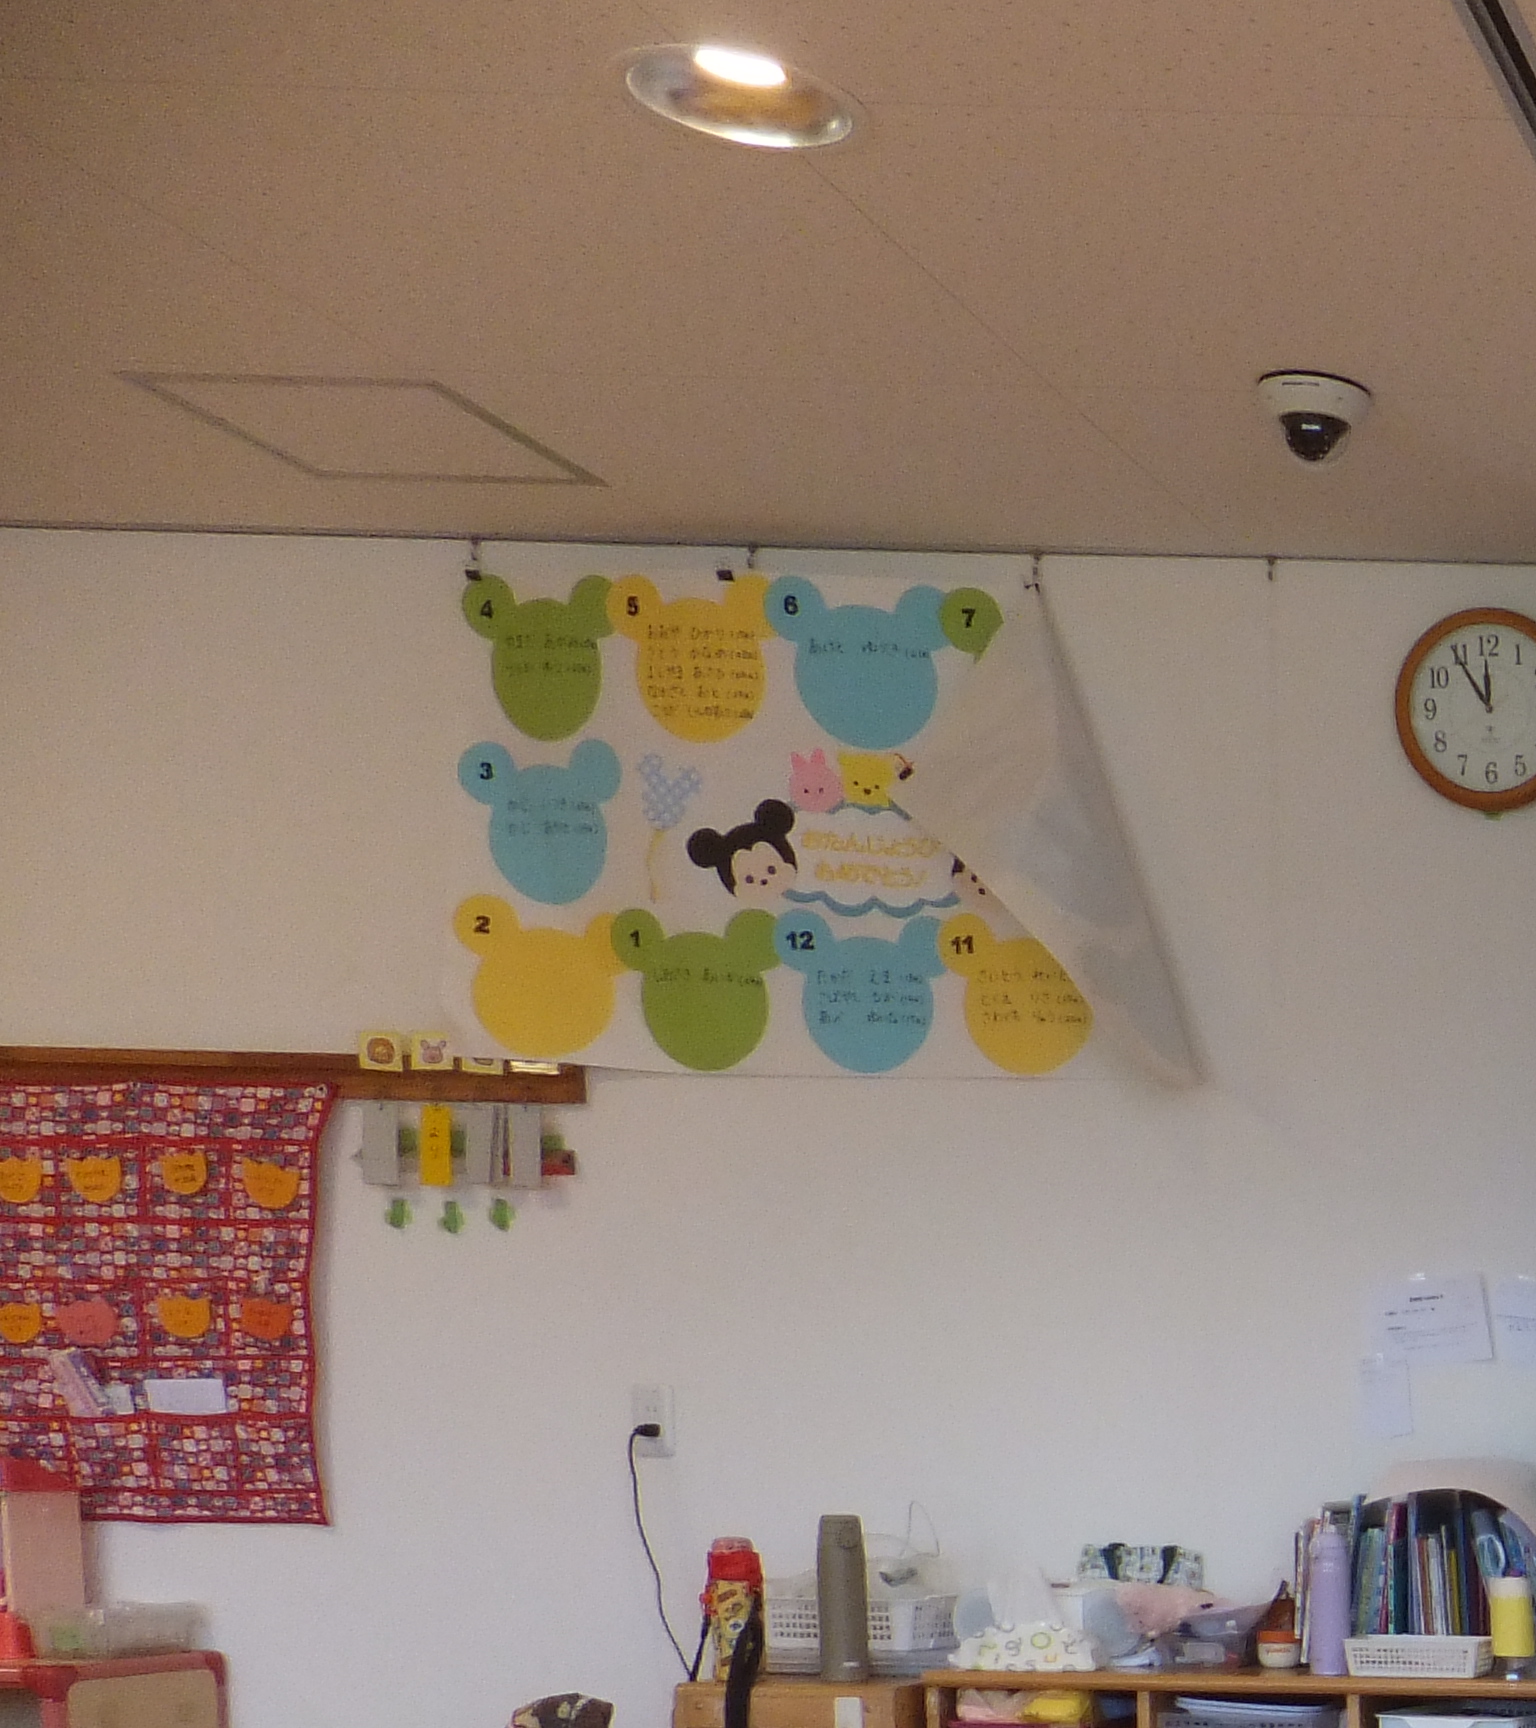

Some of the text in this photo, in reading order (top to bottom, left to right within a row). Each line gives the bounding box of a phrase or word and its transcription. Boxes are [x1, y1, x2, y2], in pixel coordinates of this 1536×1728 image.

[480, 600, 494, 619] 4
[626, 596, 640, 616] 5
[783, 595, 799, 615] 6
[961, 608, 976, 628] 7
[1478, 634, 1499, 657] 12
[1515, 644, 1523, 665] 1
[1429, 667, 1449, 689] 10
[1424, 698, 1437, 721] 9
[1433, 730, 1447, 753] 8
[479, 763, 494, 781] 3
[1457, 754, 1468, 776] 7
[1484, 761, 1498, 784] 6
[1514, 754, 1527, 777] 5
[473, 916, 490, 934] 2
[629, 929, 640, 948] 1
[785, 930, 815, 950] 12
[951, 935, 975, 955] 11
